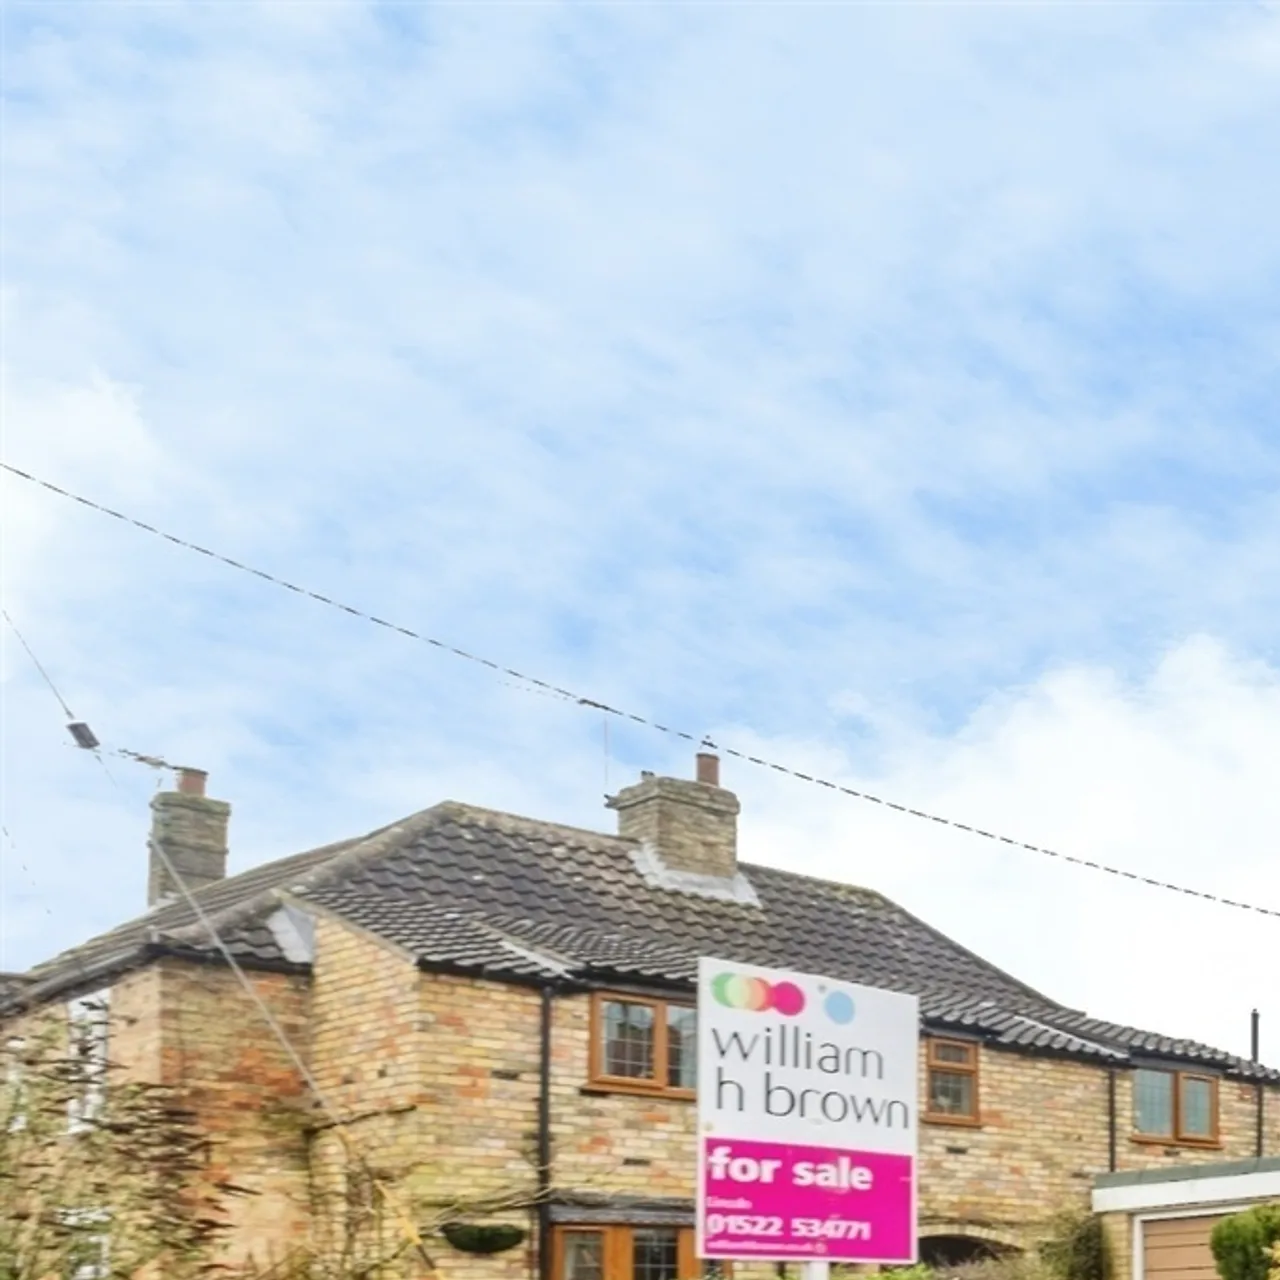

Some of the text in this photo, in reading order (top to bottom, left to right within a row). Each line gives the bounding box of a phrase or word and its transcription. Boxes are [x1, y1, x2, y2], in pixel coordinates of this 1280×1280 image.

[711, 1024, 884, 1080] william
[716, 1066, 910, 1129] h brown
[707, 1146, 873, 1190] for sale
[706, 1213, 872, 1241] 01522 534771
